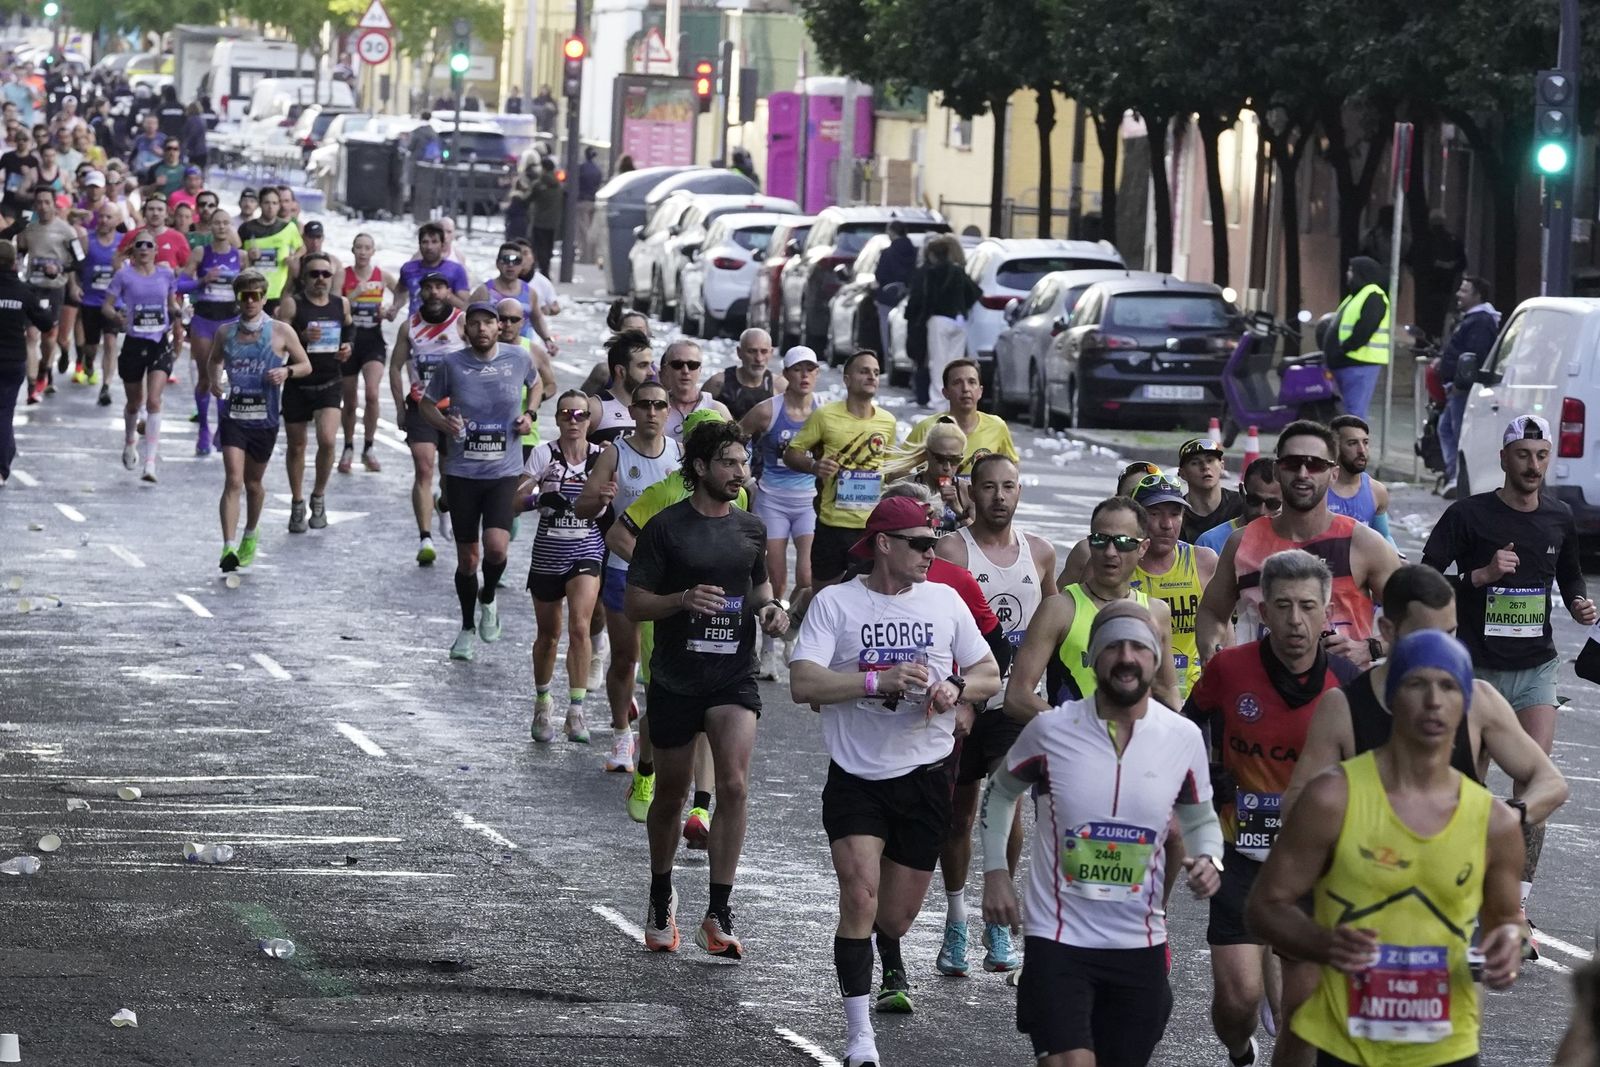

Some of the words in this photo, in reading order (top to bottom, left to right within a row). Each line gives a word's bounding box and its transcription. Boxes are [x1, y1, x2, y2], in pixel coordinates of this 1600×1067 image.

[366, 41, 385, 53] 30
[469, 442, 502, 451] FLORIAN
[624, 485, 645, 498] Sie
[1160, 595, 1198, 617] LLA
[1509, 602, 1527, 610] 2678
[711, 617, 731, 625] 5119
[1486, 613, 1545, 624] MARCOLINO
[704, 628, 734, 640] FEDE
[861, 622, 935, 648] GEORGE
[883, 652, 915, 661] ZURIC
[1263, 797, 1281, 807] ZU
[1264, 818, 1283, 828] 524
[1096, 826, 1146, 840] ZURICH
[1235, 833, 1270, 847] JOSE
[1095, 849, 1121, 861] 2448
[1079, 863, 1133, 883] BAYÓN
[1386, 950, 1440, 964] ZURICH
[1360, 997, 1443, 1019] ANTONIO
